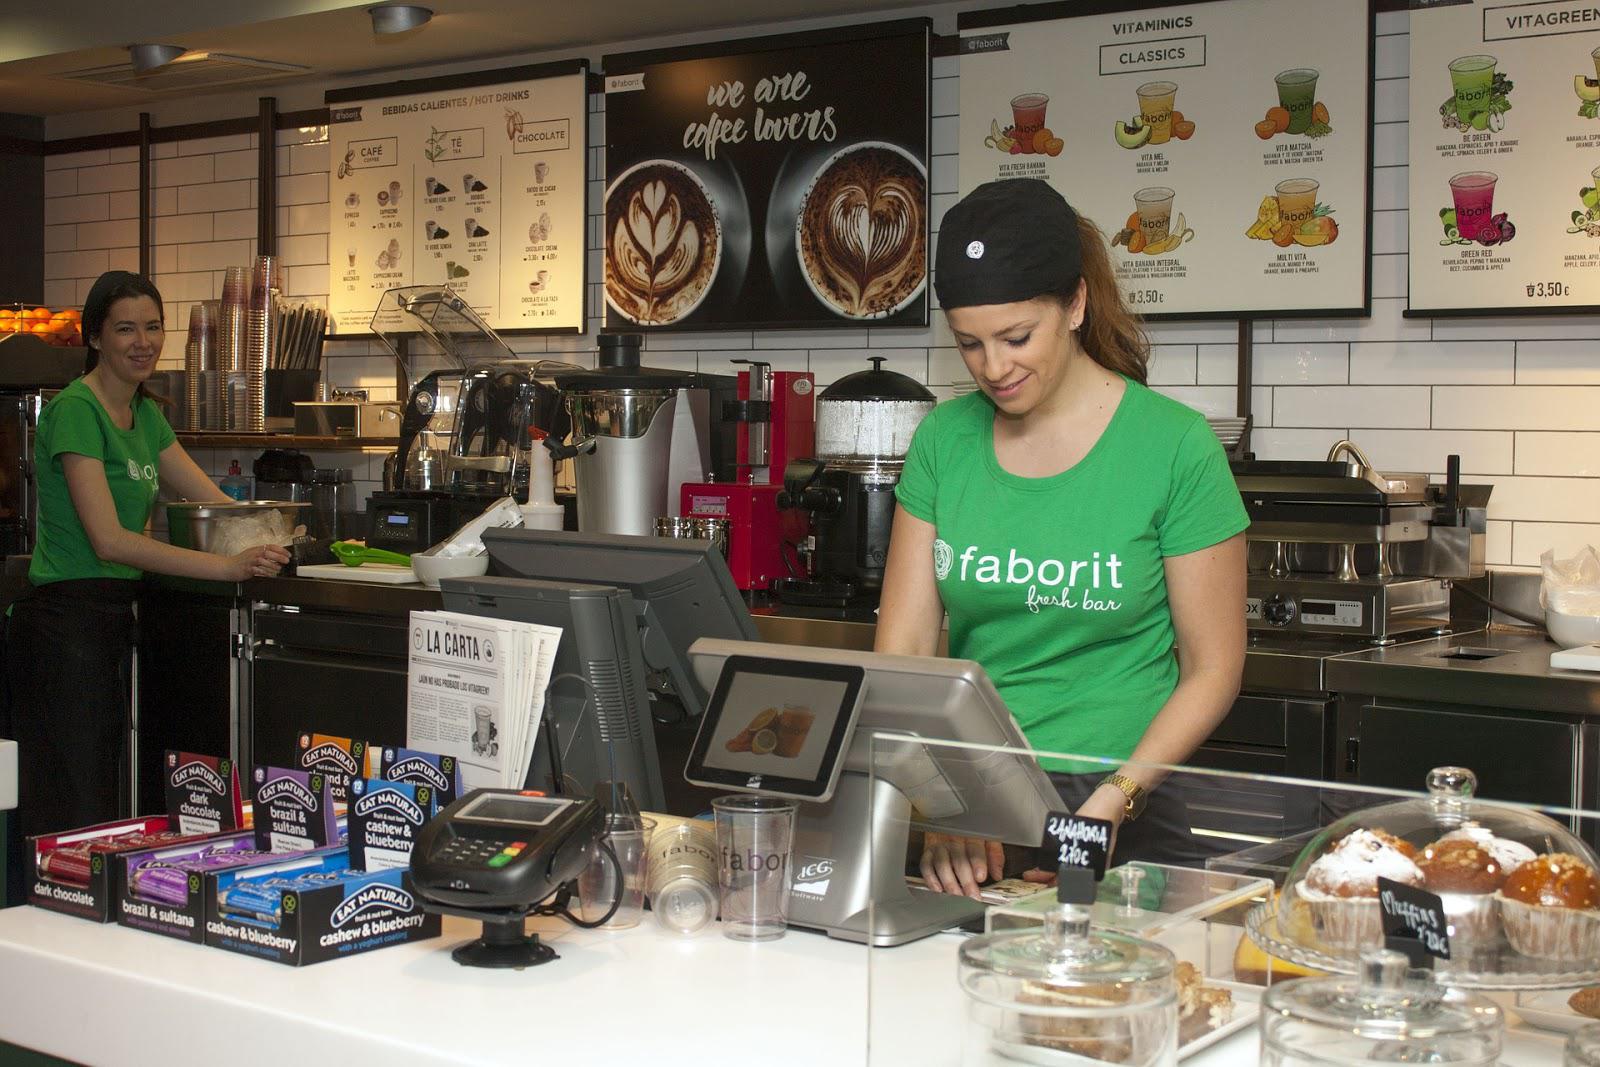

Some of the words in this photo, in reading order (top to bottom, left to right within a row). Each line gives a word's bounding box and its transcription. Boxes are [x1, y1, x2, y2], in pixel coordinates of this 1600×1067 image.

[1113, 16, 1193, 35] VITAMINICS
[1506, 8, 1600, 29] VITAGREEN
[1119, 48, 1186, 65] CLASSICS
[707, 80, 746, 108] we
[754, 71, 811, 103] are
[382, 103, 418, 116] BEBIDAS
[420, 97, 468, 111] CALIENTES
[475, 94, 495, 106] HOT
[496, 90, 530, 102] DRINKS
[451, 136, 463, 148] TÉ
[517, 131, 566, 144] CHOCOLATE
[683, 113, 748, 160] coffee
[754, 107, 837, 142] lovers
[360, 144, 383, 157] CAFÉ
[1276, 144, 1289, 152] VITA
[1290, 143, 1312, 151] MATCHA
[1461, 250, 1479, 258] GREEN
[960, 545, 1123, 588] faborit
[1025, 584, 1077, 614] fresh
[1082, 588, 1121, 611] bar
[427, 629, 442, 654] LA
[445, 631, 480, 661] CARTA
[306, 750, 320, 763] EAT
[320, 748, 354, 771] NATURAL
[175, 769, 188, 783] EAT
[188, 766, 223, 790] NATURAL
[391, 765, 406, 777] EAT
[407, 762, 444, 787] NATURAL
[262, 785, 276, 799] EAT
[277, 782, 314, 808] NATURAL
[354, 782, 363, 790] 12
[190, 792, 208, 805] dark
[360, 796, 376, 811] EAT
[378, 793, 419, 821] NATURAL
[180, 803, 221, 820] chocolate
[270, 806, 297, 822] brazil
[299, 811, 306, 823] &
[272, 821, 307, 836] sultana
[366, 821, 403, 836] cashew
[403, 825, 412, 838] &
[365, 832, 414, 852] blueberry
[800, 860, 832, 879] ICG
[34, 882, 57, 896] dark
[54, 886, 95, 906] chocolate
[336, 899, 357, 921] EAT
[358, 888, 409, 908] NATURAL
[122, 899, 149, 918] brazil
[149, 906, 158, 920] &
[159, 909, 195, 928] sultana
[355, 914, 366, 923] fruit
[1381, 890, 1439, 929] Muffins
[206, 921, 240, 939] cashew
[240, 926, 249, 940] &
[248, 927, 297, 953] blueberry
[320, 929, 361, 947] cashew
[362, 923, 371, 937] &
[372, 914, 425, 936] blueberry
